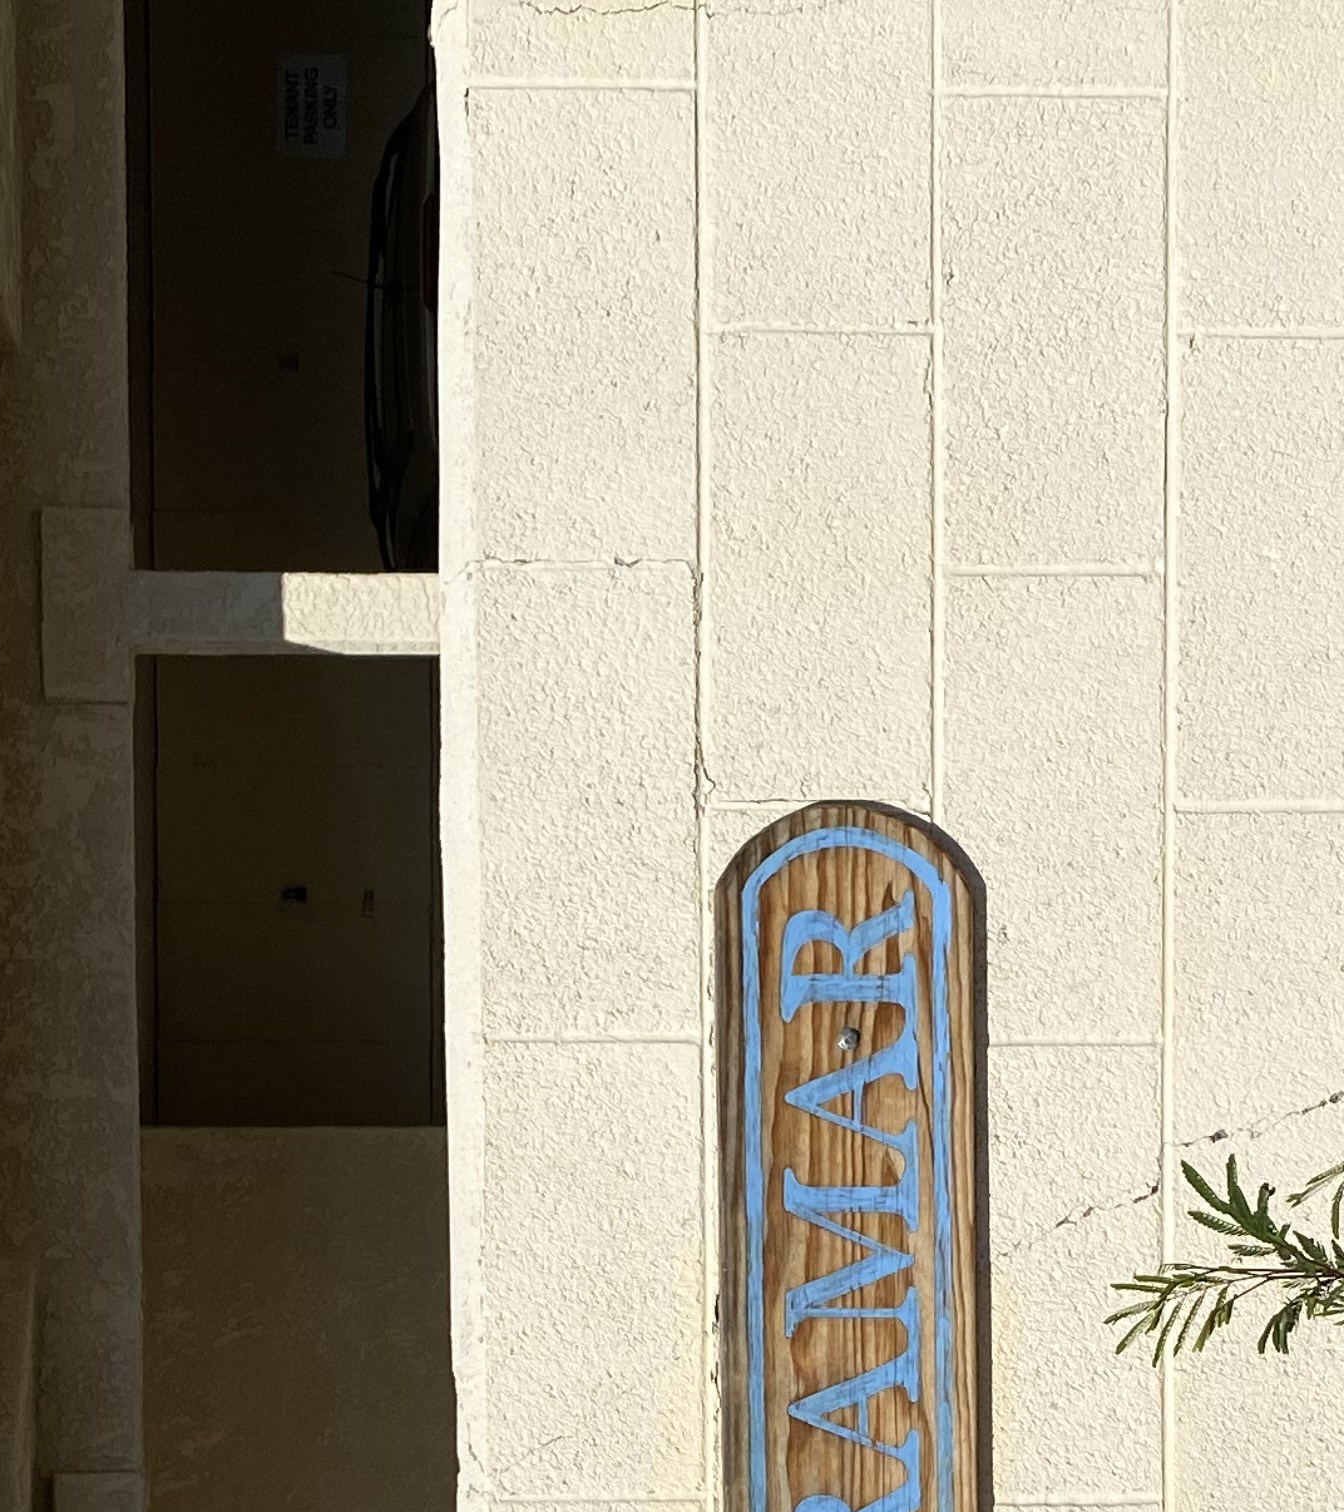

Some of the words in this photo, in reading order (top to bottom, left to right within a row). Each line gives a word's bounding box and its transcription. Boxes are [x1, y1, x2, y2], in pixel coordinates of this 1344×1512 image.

[284, 69, 299, 141] TENANT
[304, 67, 319, 145] PARKING
[323, 84, 338, 129] ONLY
